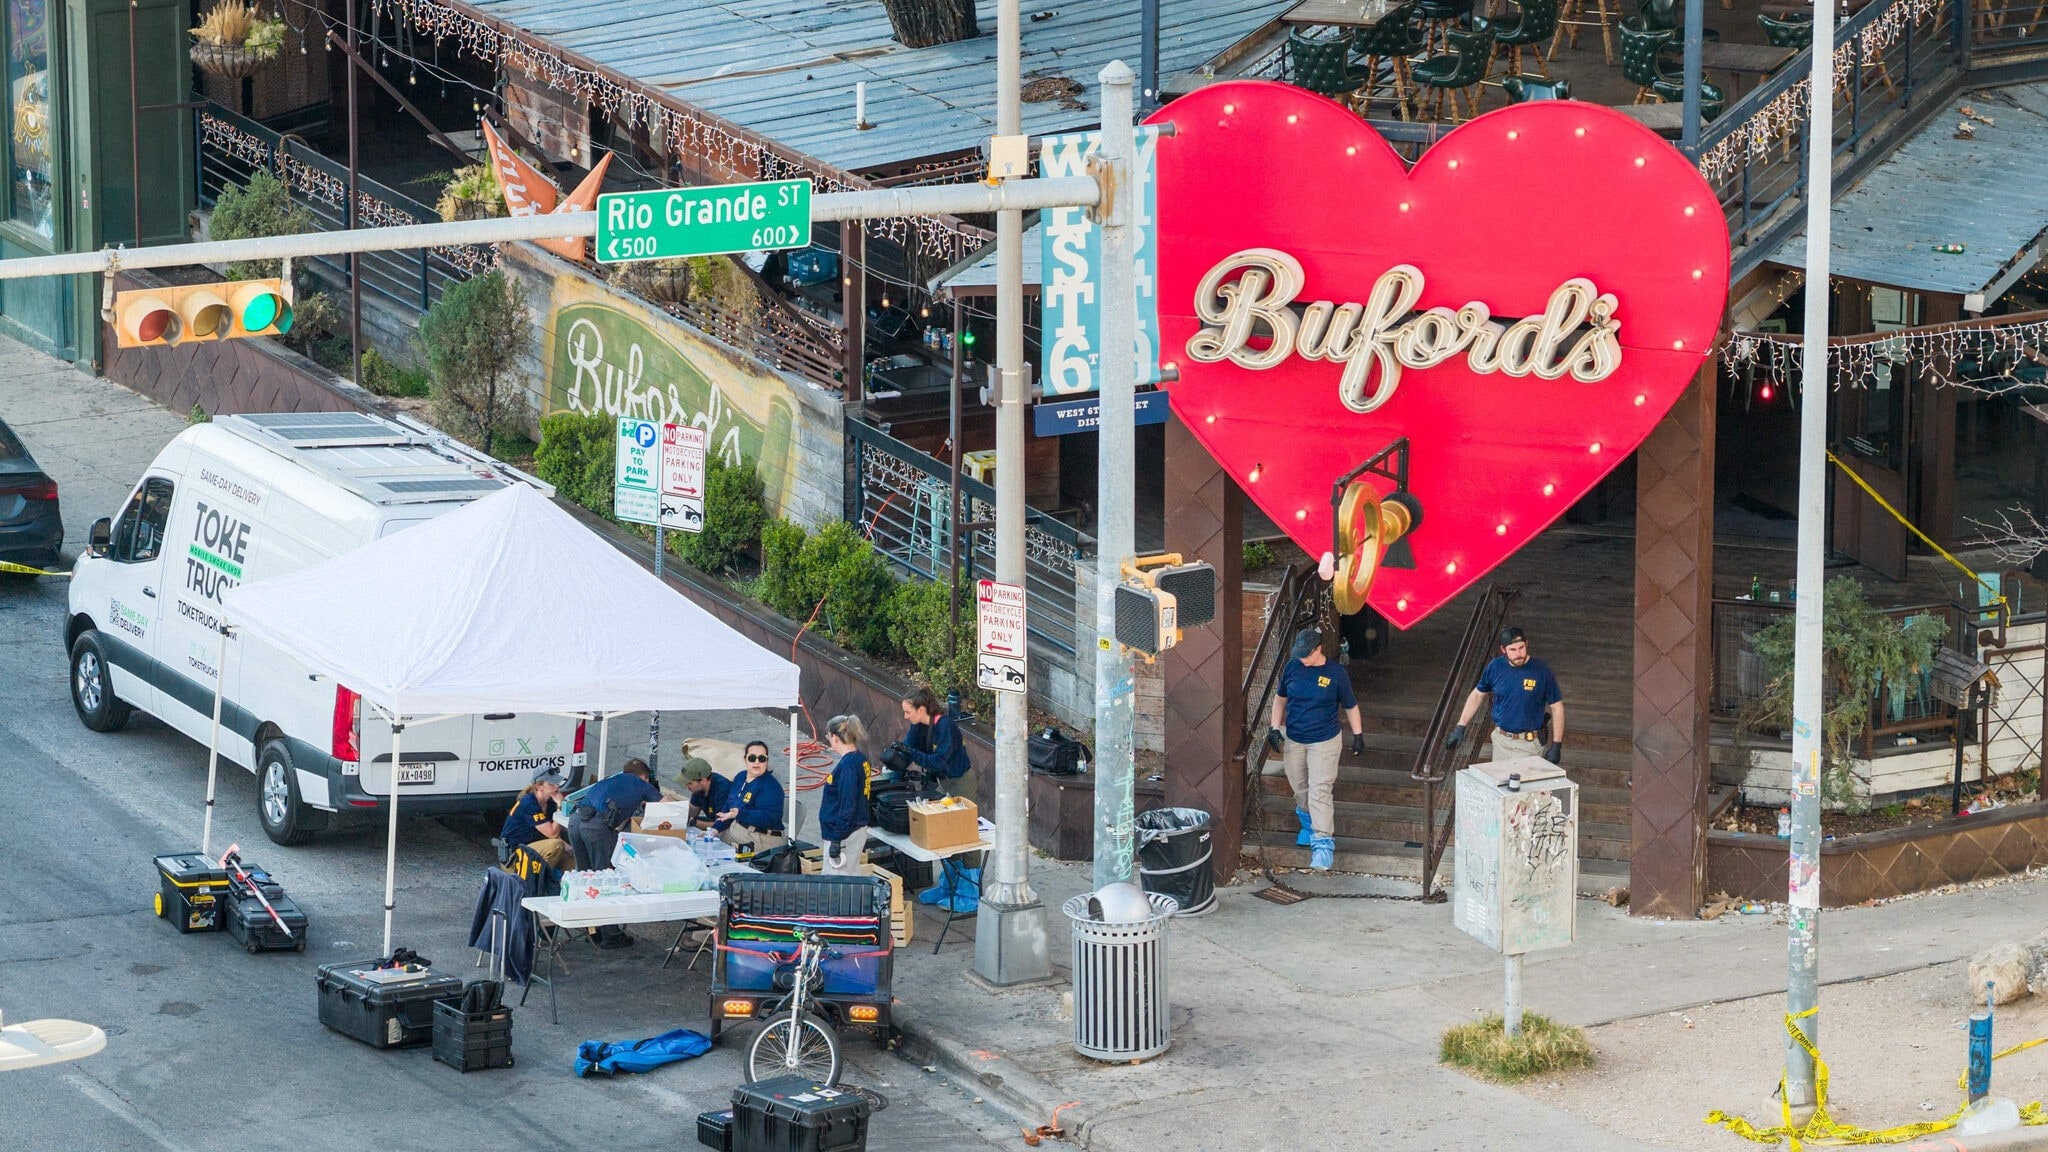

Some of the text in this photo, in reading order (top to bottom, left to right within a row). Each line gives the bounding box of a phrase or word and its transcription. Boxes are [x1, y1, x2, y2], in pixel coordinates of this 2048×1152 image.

[608, 197, 653, 231] Rio
[665, 189, 767, 227] Grande
[778, 184, 801, 207] ST
[752, 226, 786, 247] 600
[622, 236, 657, 257] 500
[1186, 247, 1623, 413] Buford's
[1050, 335, 1100, 394] 6T
[1057, 406, 1100, 419] WEST 6T
[664, 427, 703, 443] NO PARKING
[630, 447, 646, 457] PAY
[665, 446, 702, 460] MOTORCYCLE
[633, 457, 643, 466] TO
[666, 457, 701, 472] PARKING
[626, 466, 649, 477] PARK
[672, 472, 693, 484] ONLY
[200, 468, 262, 507] SAME-DAY DELIVERY
[194, 501, 251, 565] TOKE
[209, 555, 226, 570] SMOKE
[227, 563, 241, 577] SHOP
[186, 557, 240, 605] TRUC
[980, 584, 1022, 602] NO PARKING
[981, 603, 1022, 618] MOTORCYCLE
[120, 618, 145, 639] DELIVERY
[983, 615, 1021, 630] PARKING
[991, 631, 1013, 643] ONLY
[188, 656, 218, 679] TOKETRUCKS
[1318, 676, 1331, 685] FBI
[1523, 679, 1536, 687] FBI
[478, 756, 565, 772] TOKETRUCKS
